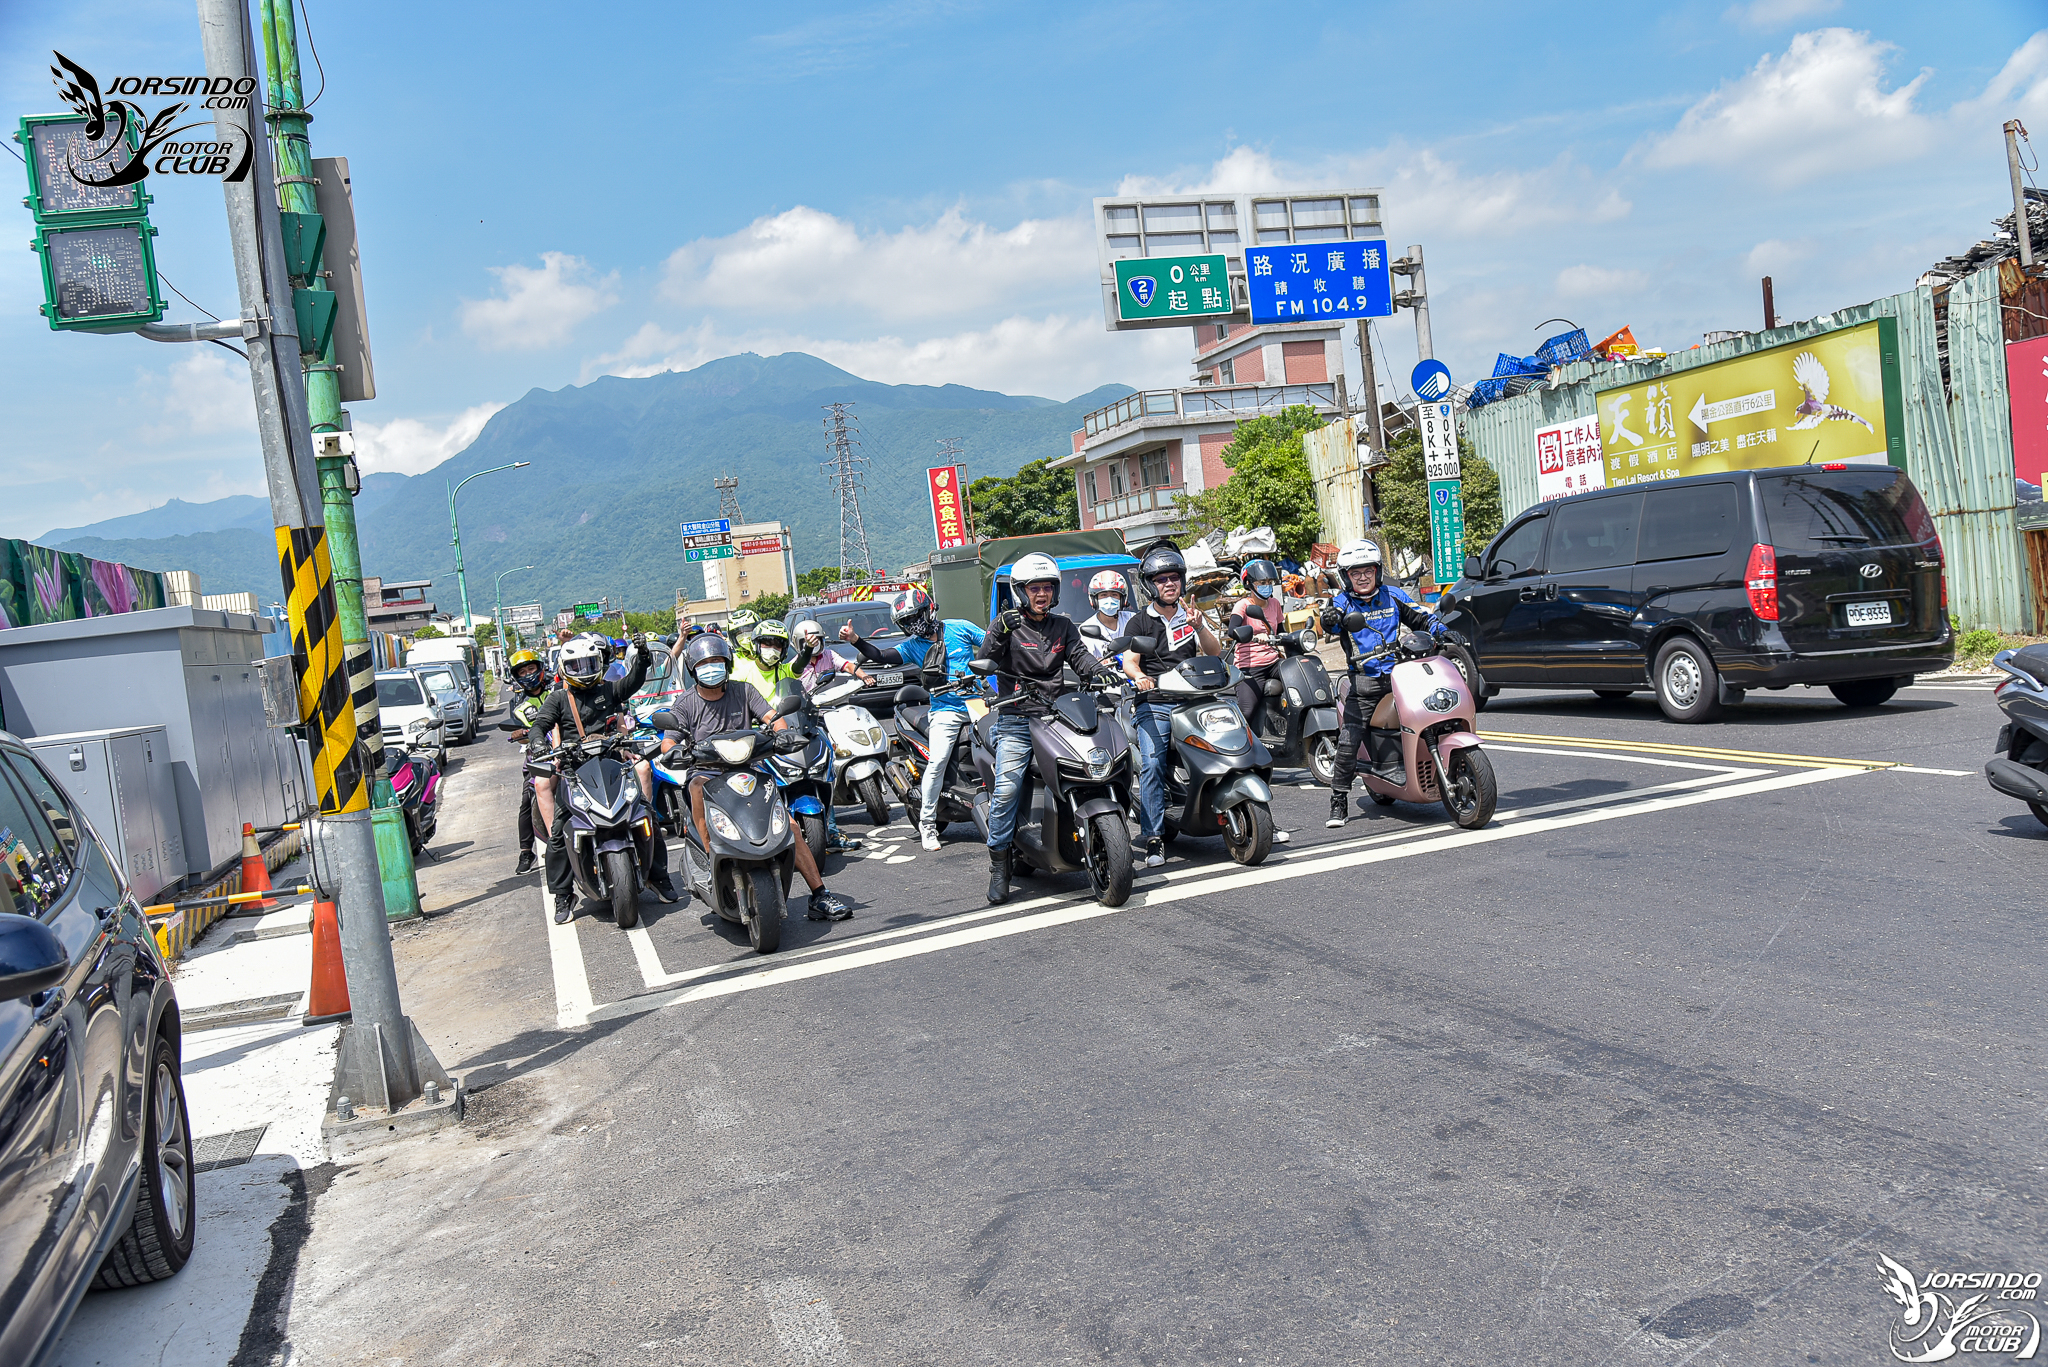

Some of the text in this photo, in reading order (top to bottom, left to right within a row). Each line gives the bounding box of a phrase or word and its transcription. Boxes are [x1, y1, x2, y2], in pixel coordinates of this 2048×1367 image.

[1253, 248, 1381, 277] 路況廣播
[1170, 263, 1211, 284] 0 公里
[1138, 280, 1148, 293] 2
[1274, 276, 1366, 296] 請收聽
[1140, 293, 1149, 303] 甲
[1168, 287, 1222, 311] 起點
[1276, 299, 1304, 316] FM
[1312, 295, 1367, 314] 104.9
[1691, 437, 1730, 458] 陽明之美
[1610, 446, 1678, 470] 渡假酒店
[1565, 473, 1587, 488] 電話
[1611, 477, 1626, 487] Tien
[1637, 470, 1659, 484] Resort
[1659, 469, 1665, 479] &
[1666, 467, 1680, 480] Spa
[936, 489, 960, 538] 金食在
[725, 534, 731, 542] 5
[724, 548, 733, 556] 13
